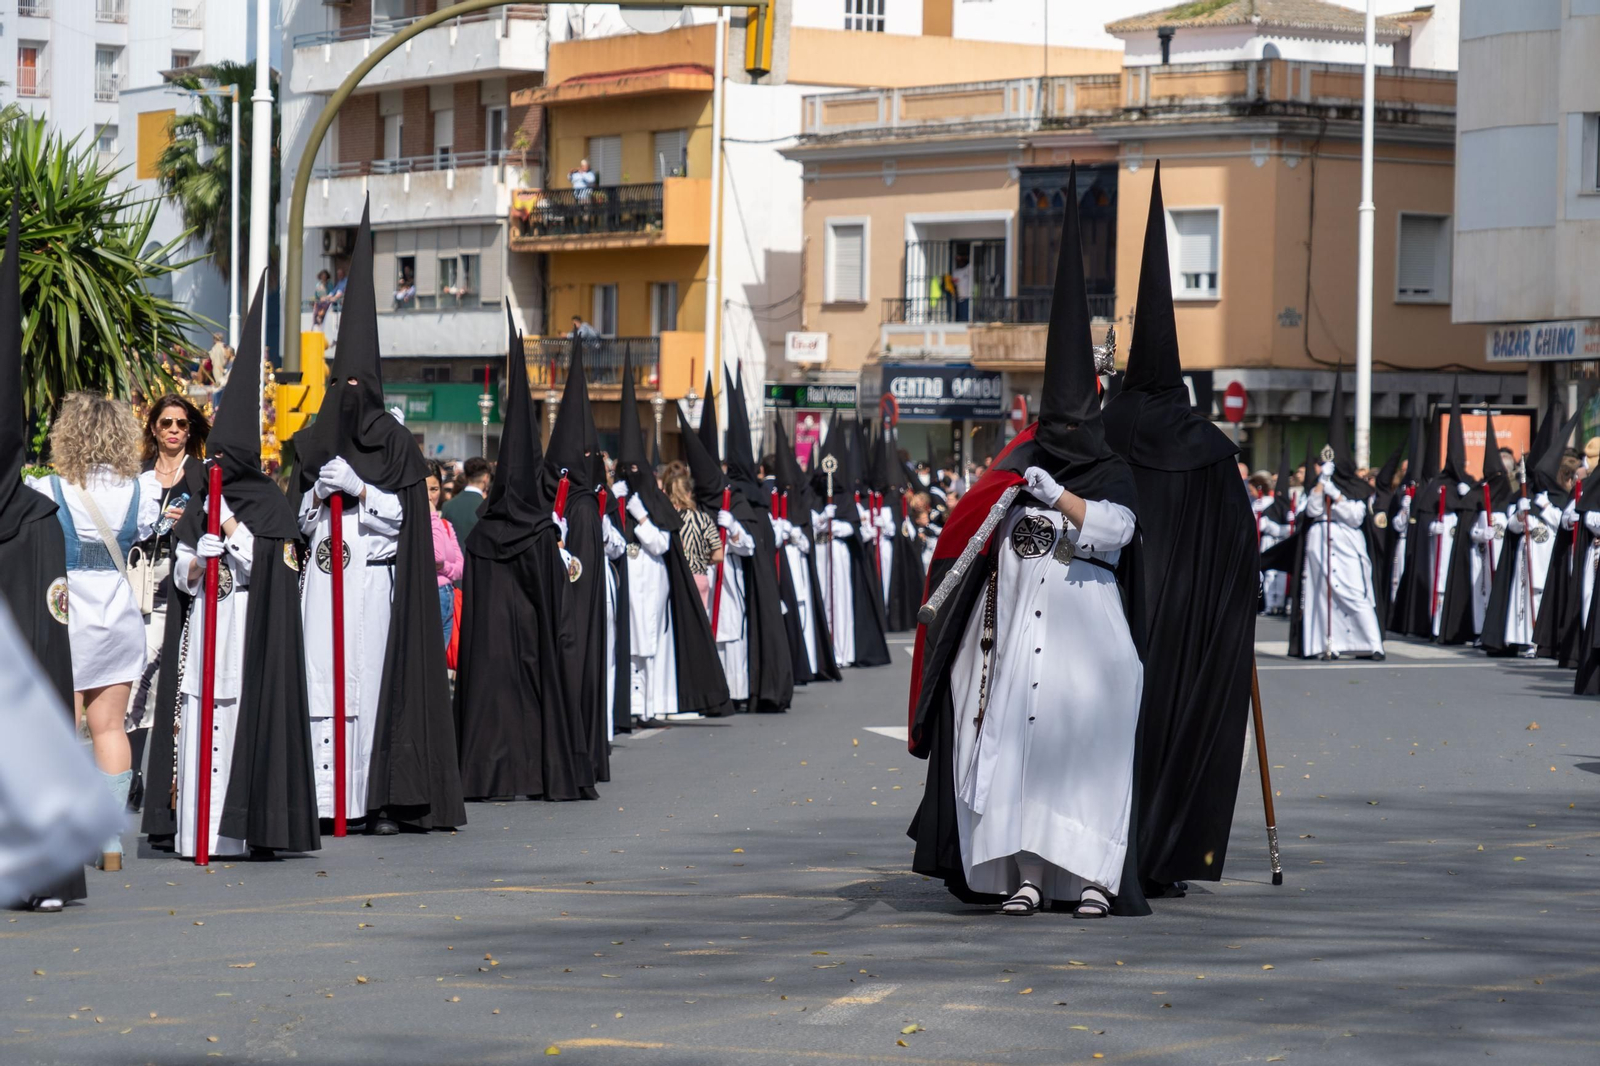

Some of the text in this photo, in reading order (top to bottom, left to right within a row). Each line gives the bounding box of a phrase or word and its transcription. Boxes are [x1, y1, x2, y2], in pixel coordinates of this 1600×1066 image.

[1493, 327, 1575, 357] BAZAR CHINO
[824, 386, 856, 403] Velasco
[890, 377, 943, 398] CENTRO
[951, 375, 1002, 398] BAMBÚ
